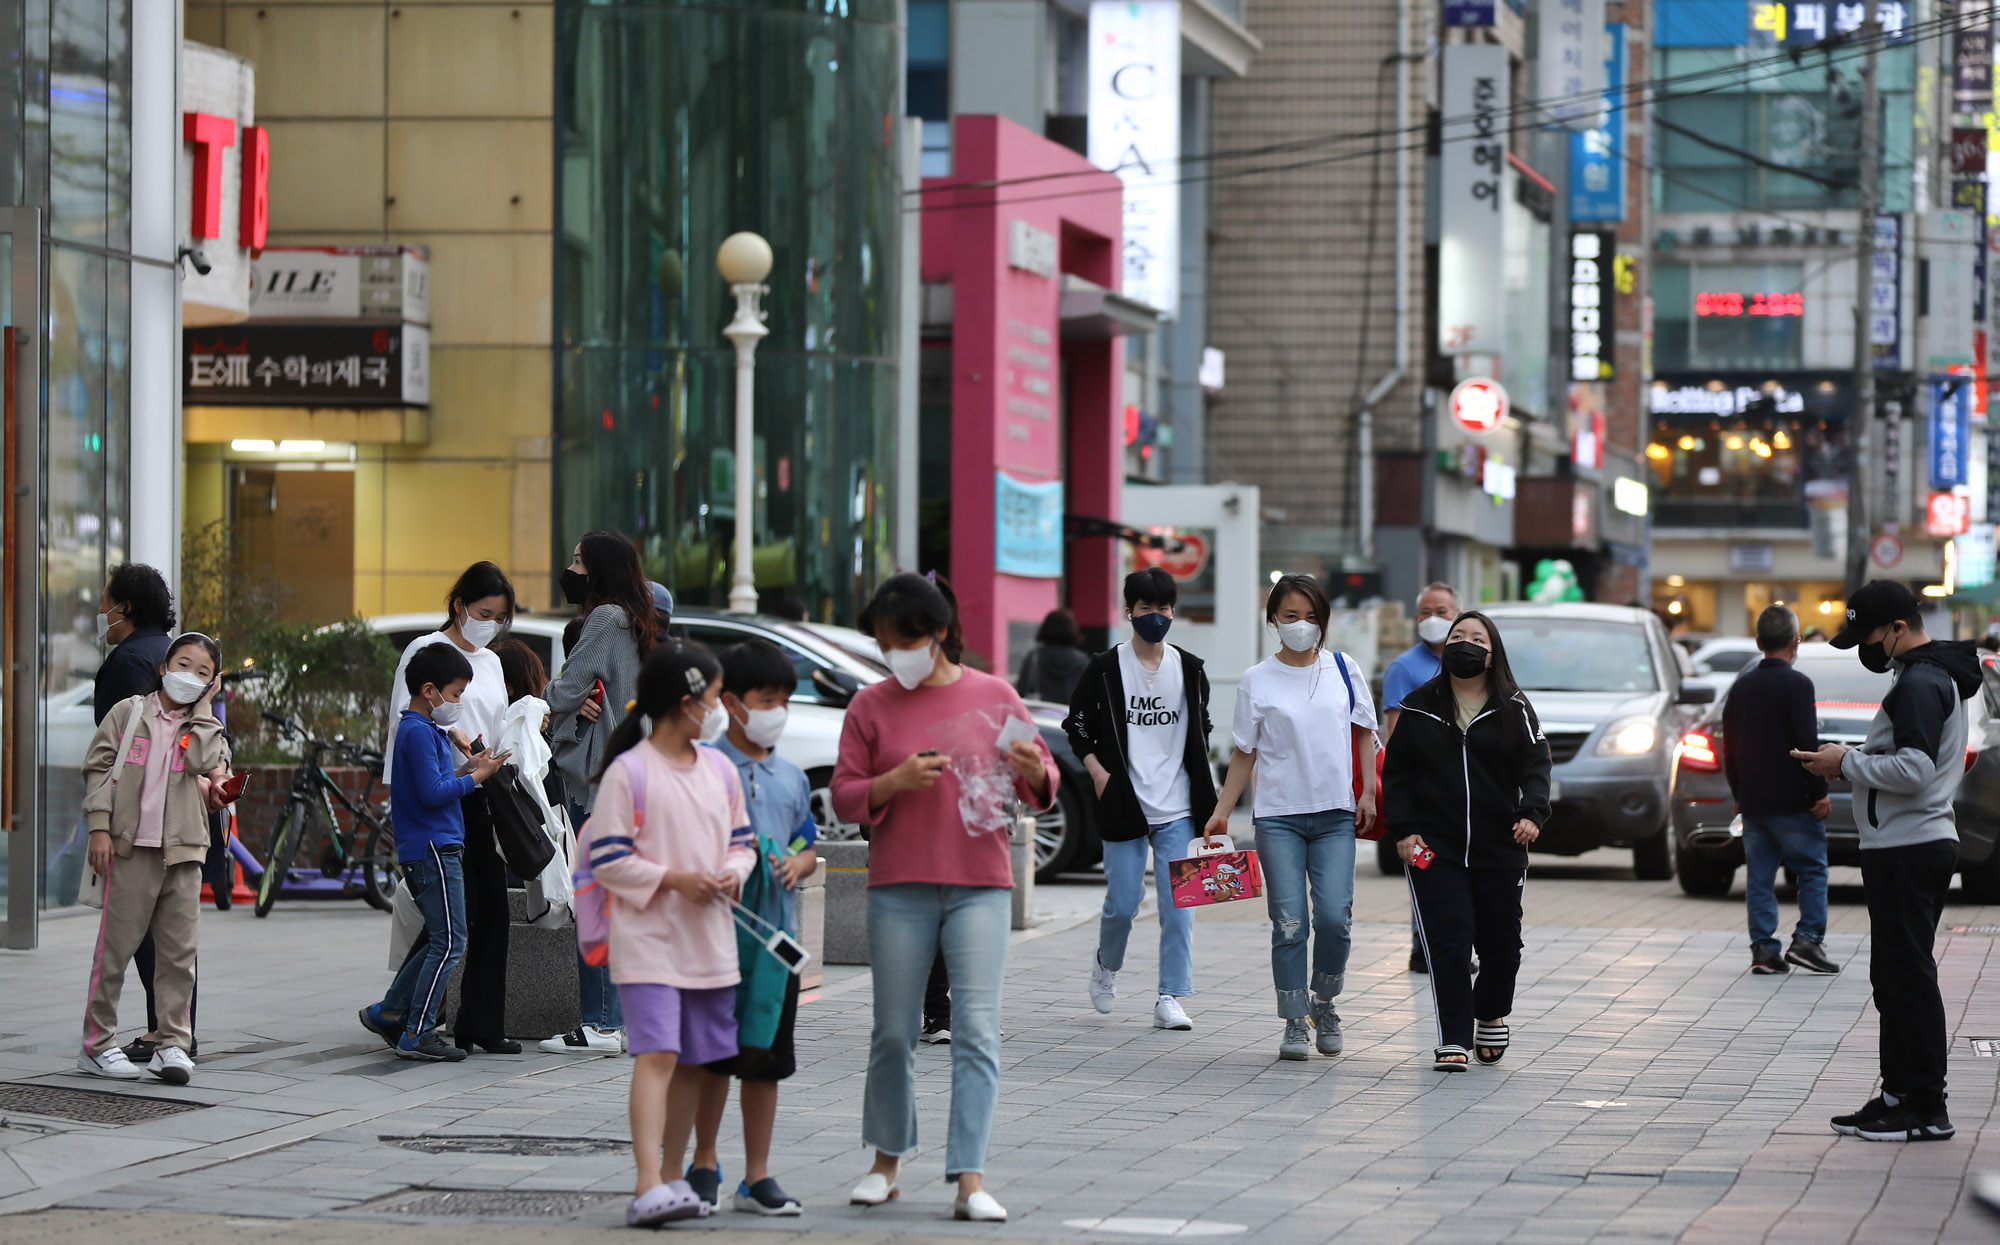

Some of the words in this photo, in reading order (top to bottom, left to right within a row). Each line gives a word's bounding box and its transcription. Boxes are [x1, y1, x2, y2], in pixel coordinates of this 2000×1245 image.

[254, 355, 389, 387] 수학의제국
[1130, 695, 1166, 711] LMC.
[1126, 709, 1181, 726] ELIGION
